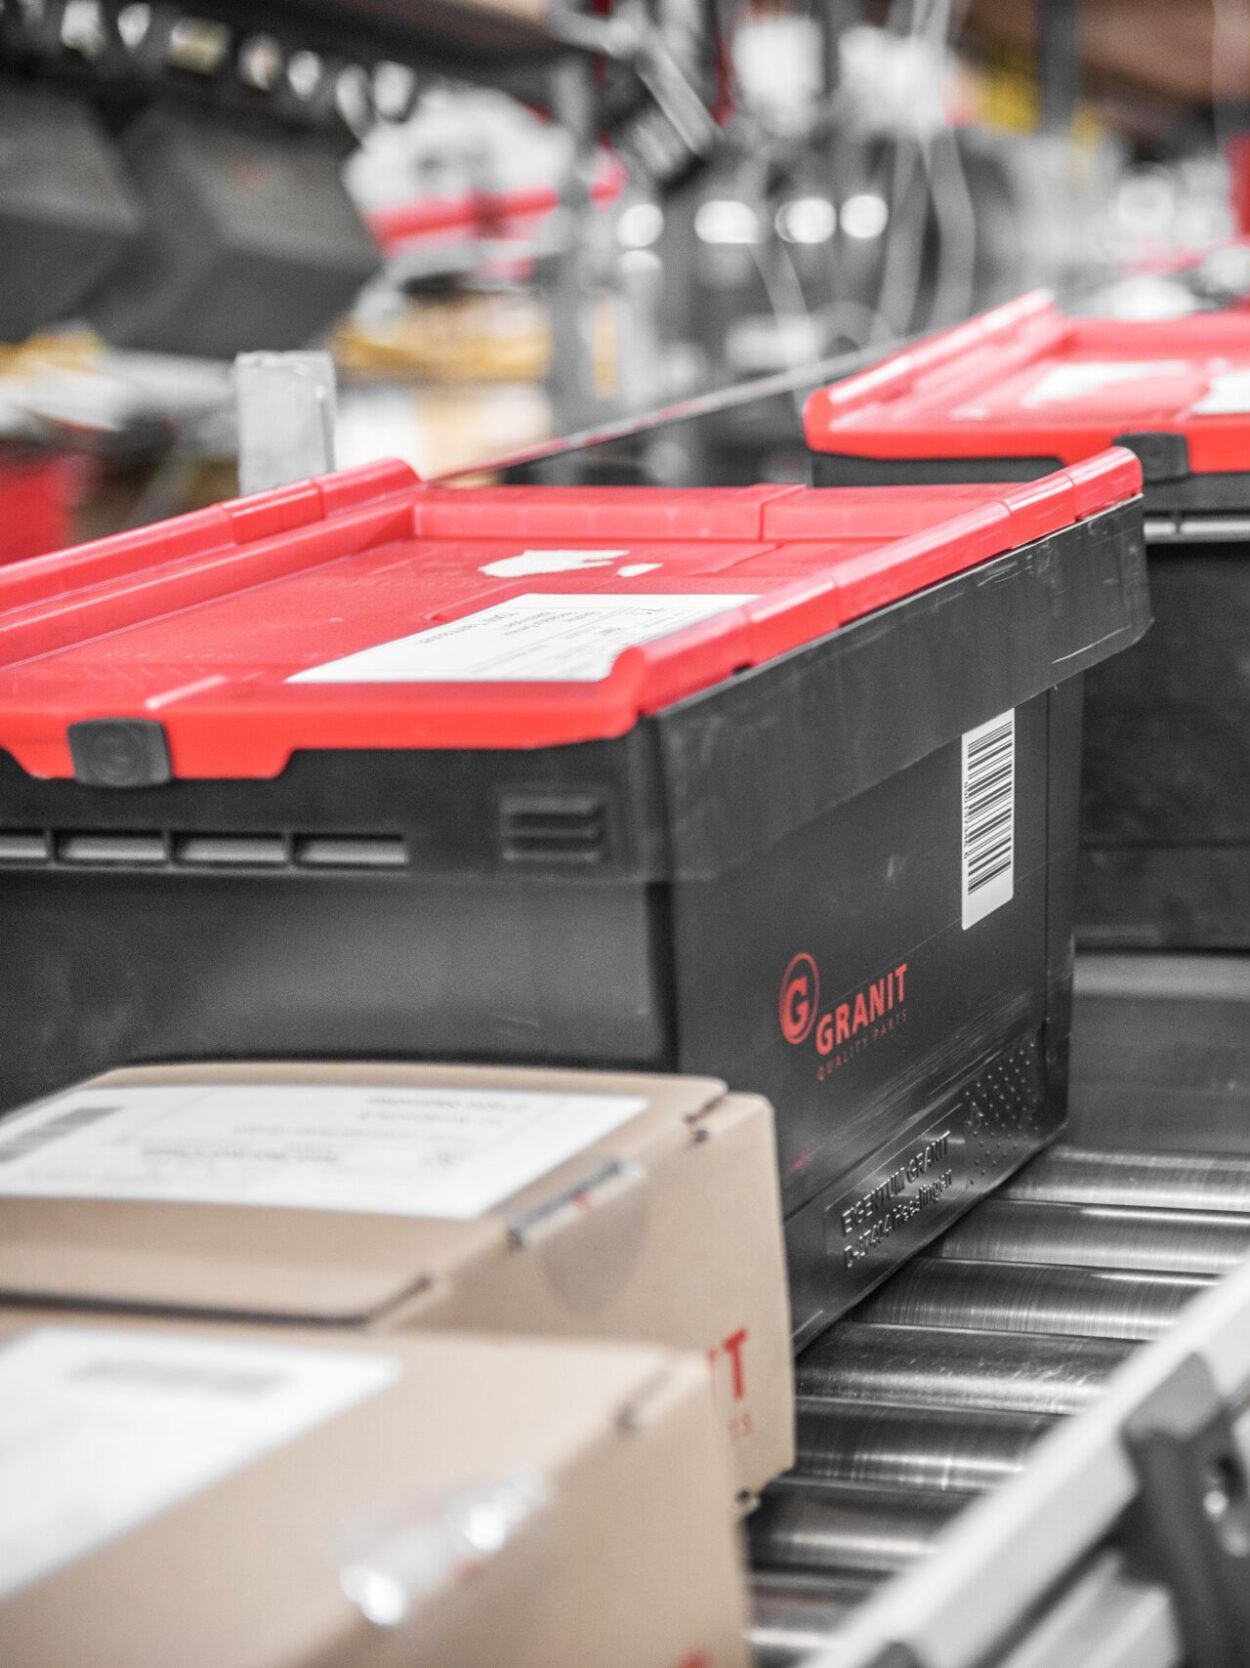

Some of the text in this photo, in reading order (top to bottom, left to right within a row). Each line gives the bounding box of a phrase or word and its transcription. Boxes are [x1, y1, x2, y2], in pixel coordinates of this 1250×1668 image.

[815, 962, 908, 1056] GRANIT
[816, 1007, 908, 1081] QUALITY PARTS
[905, 1129, 951, 1184] GRANIT
